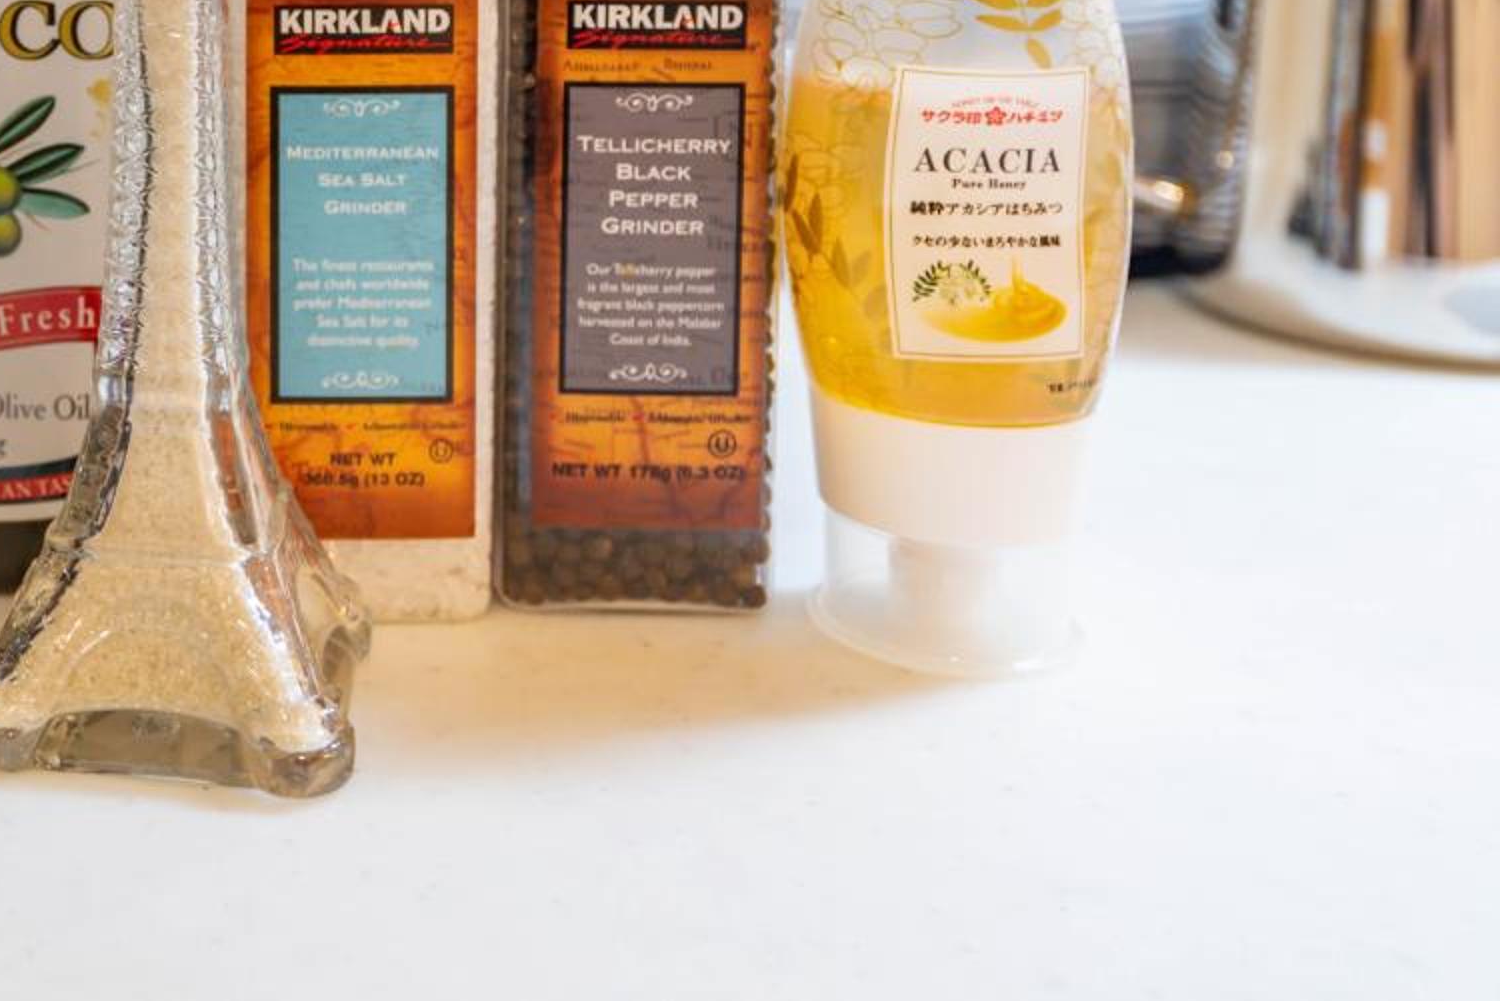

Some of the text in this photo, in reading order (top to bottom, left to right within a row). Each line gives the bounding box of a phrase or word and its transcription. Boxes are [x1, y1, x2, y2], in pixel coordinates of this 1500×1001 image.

[279, 8, 450, 34] KIRKLAND
[573, 4, 744, 30] KIRKLAND
[913, 146, 1061, 173] ACACIA
[951, 177, 1027, 191] Pure Honey
[53, 394, 90, 421] Oil
[330, 452, 397, 467] NET WT
[552, 462, 588, 477] NET
[594, 462, 621, 477] WT
